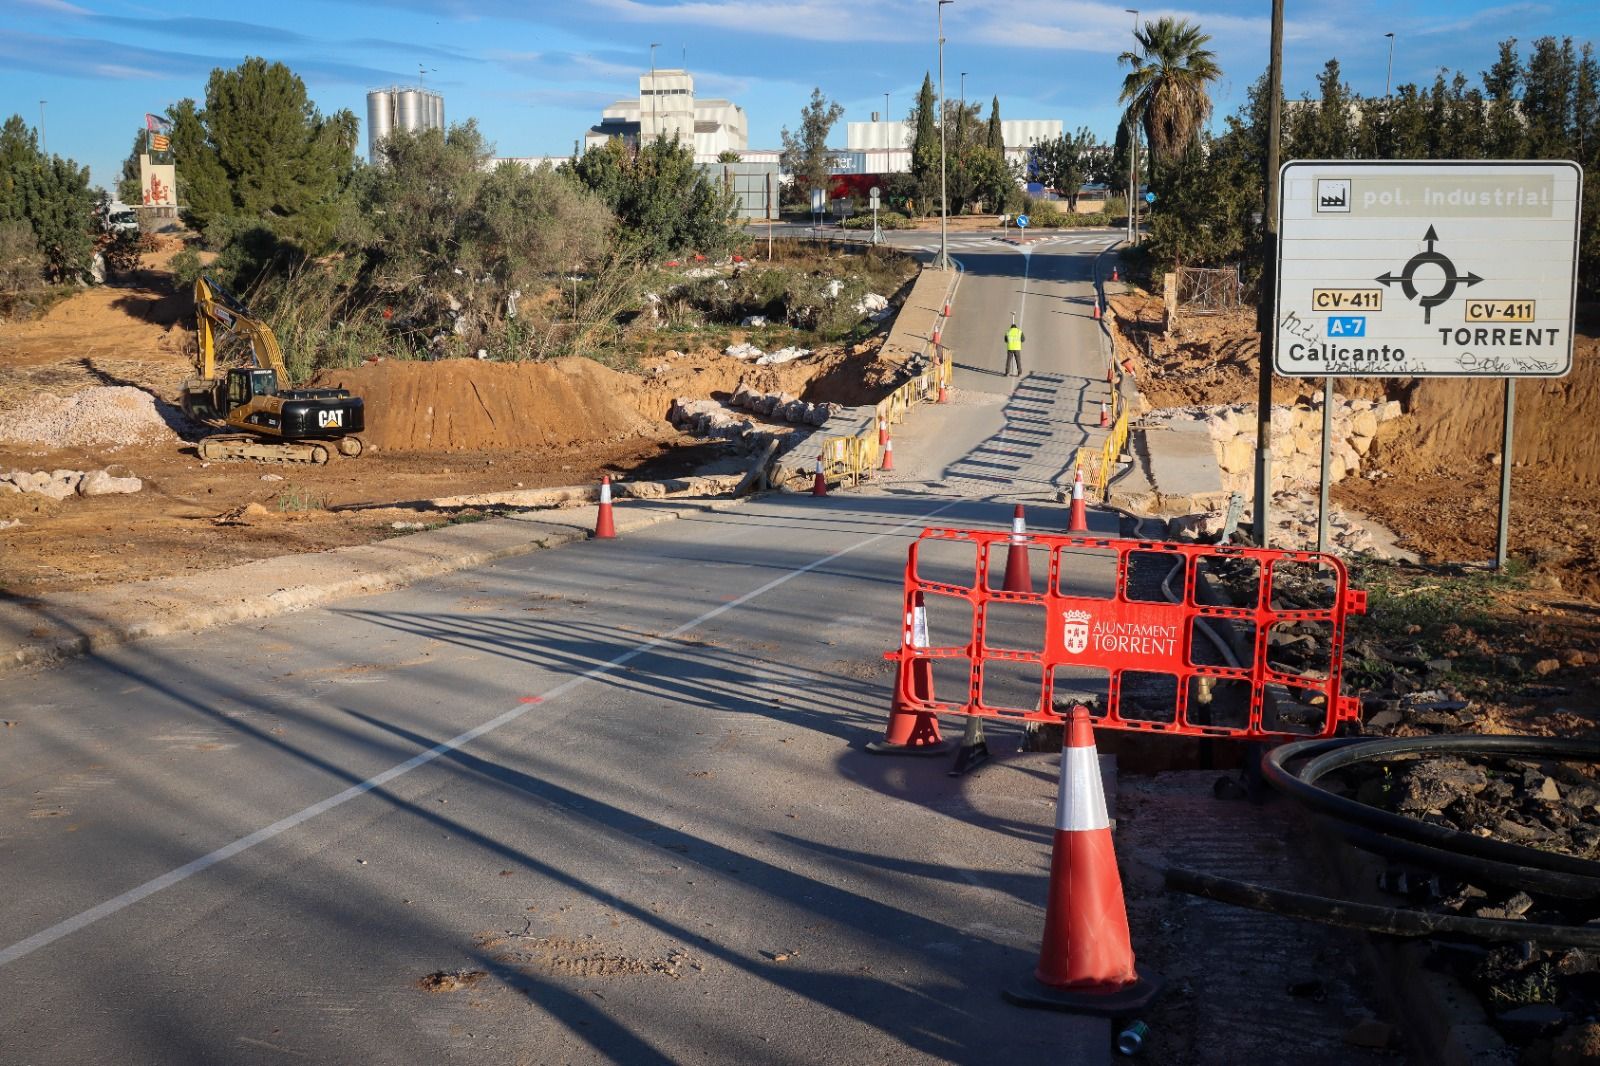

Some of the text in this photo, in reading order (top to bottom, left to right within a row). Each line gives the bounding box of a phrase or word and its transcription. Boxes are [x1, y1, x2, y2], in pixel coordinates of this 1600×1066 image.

[1363, 187, 1550, 209] pol. industrial
[1316, 292, 1379, 309] CV-411
[1470, 302, 1533, 320] CV-411
[1330, 319, 1364, 334] A-7
[1438, 328, 1560, 346] TORRENT
[1289, 343, 1406, 362] Calicanto
[318, 409, 344, 428] CAT
[1092, 621, 1178, 638] AJUNTAMENT
[1092, 633, 1178, 657] TORRENT
